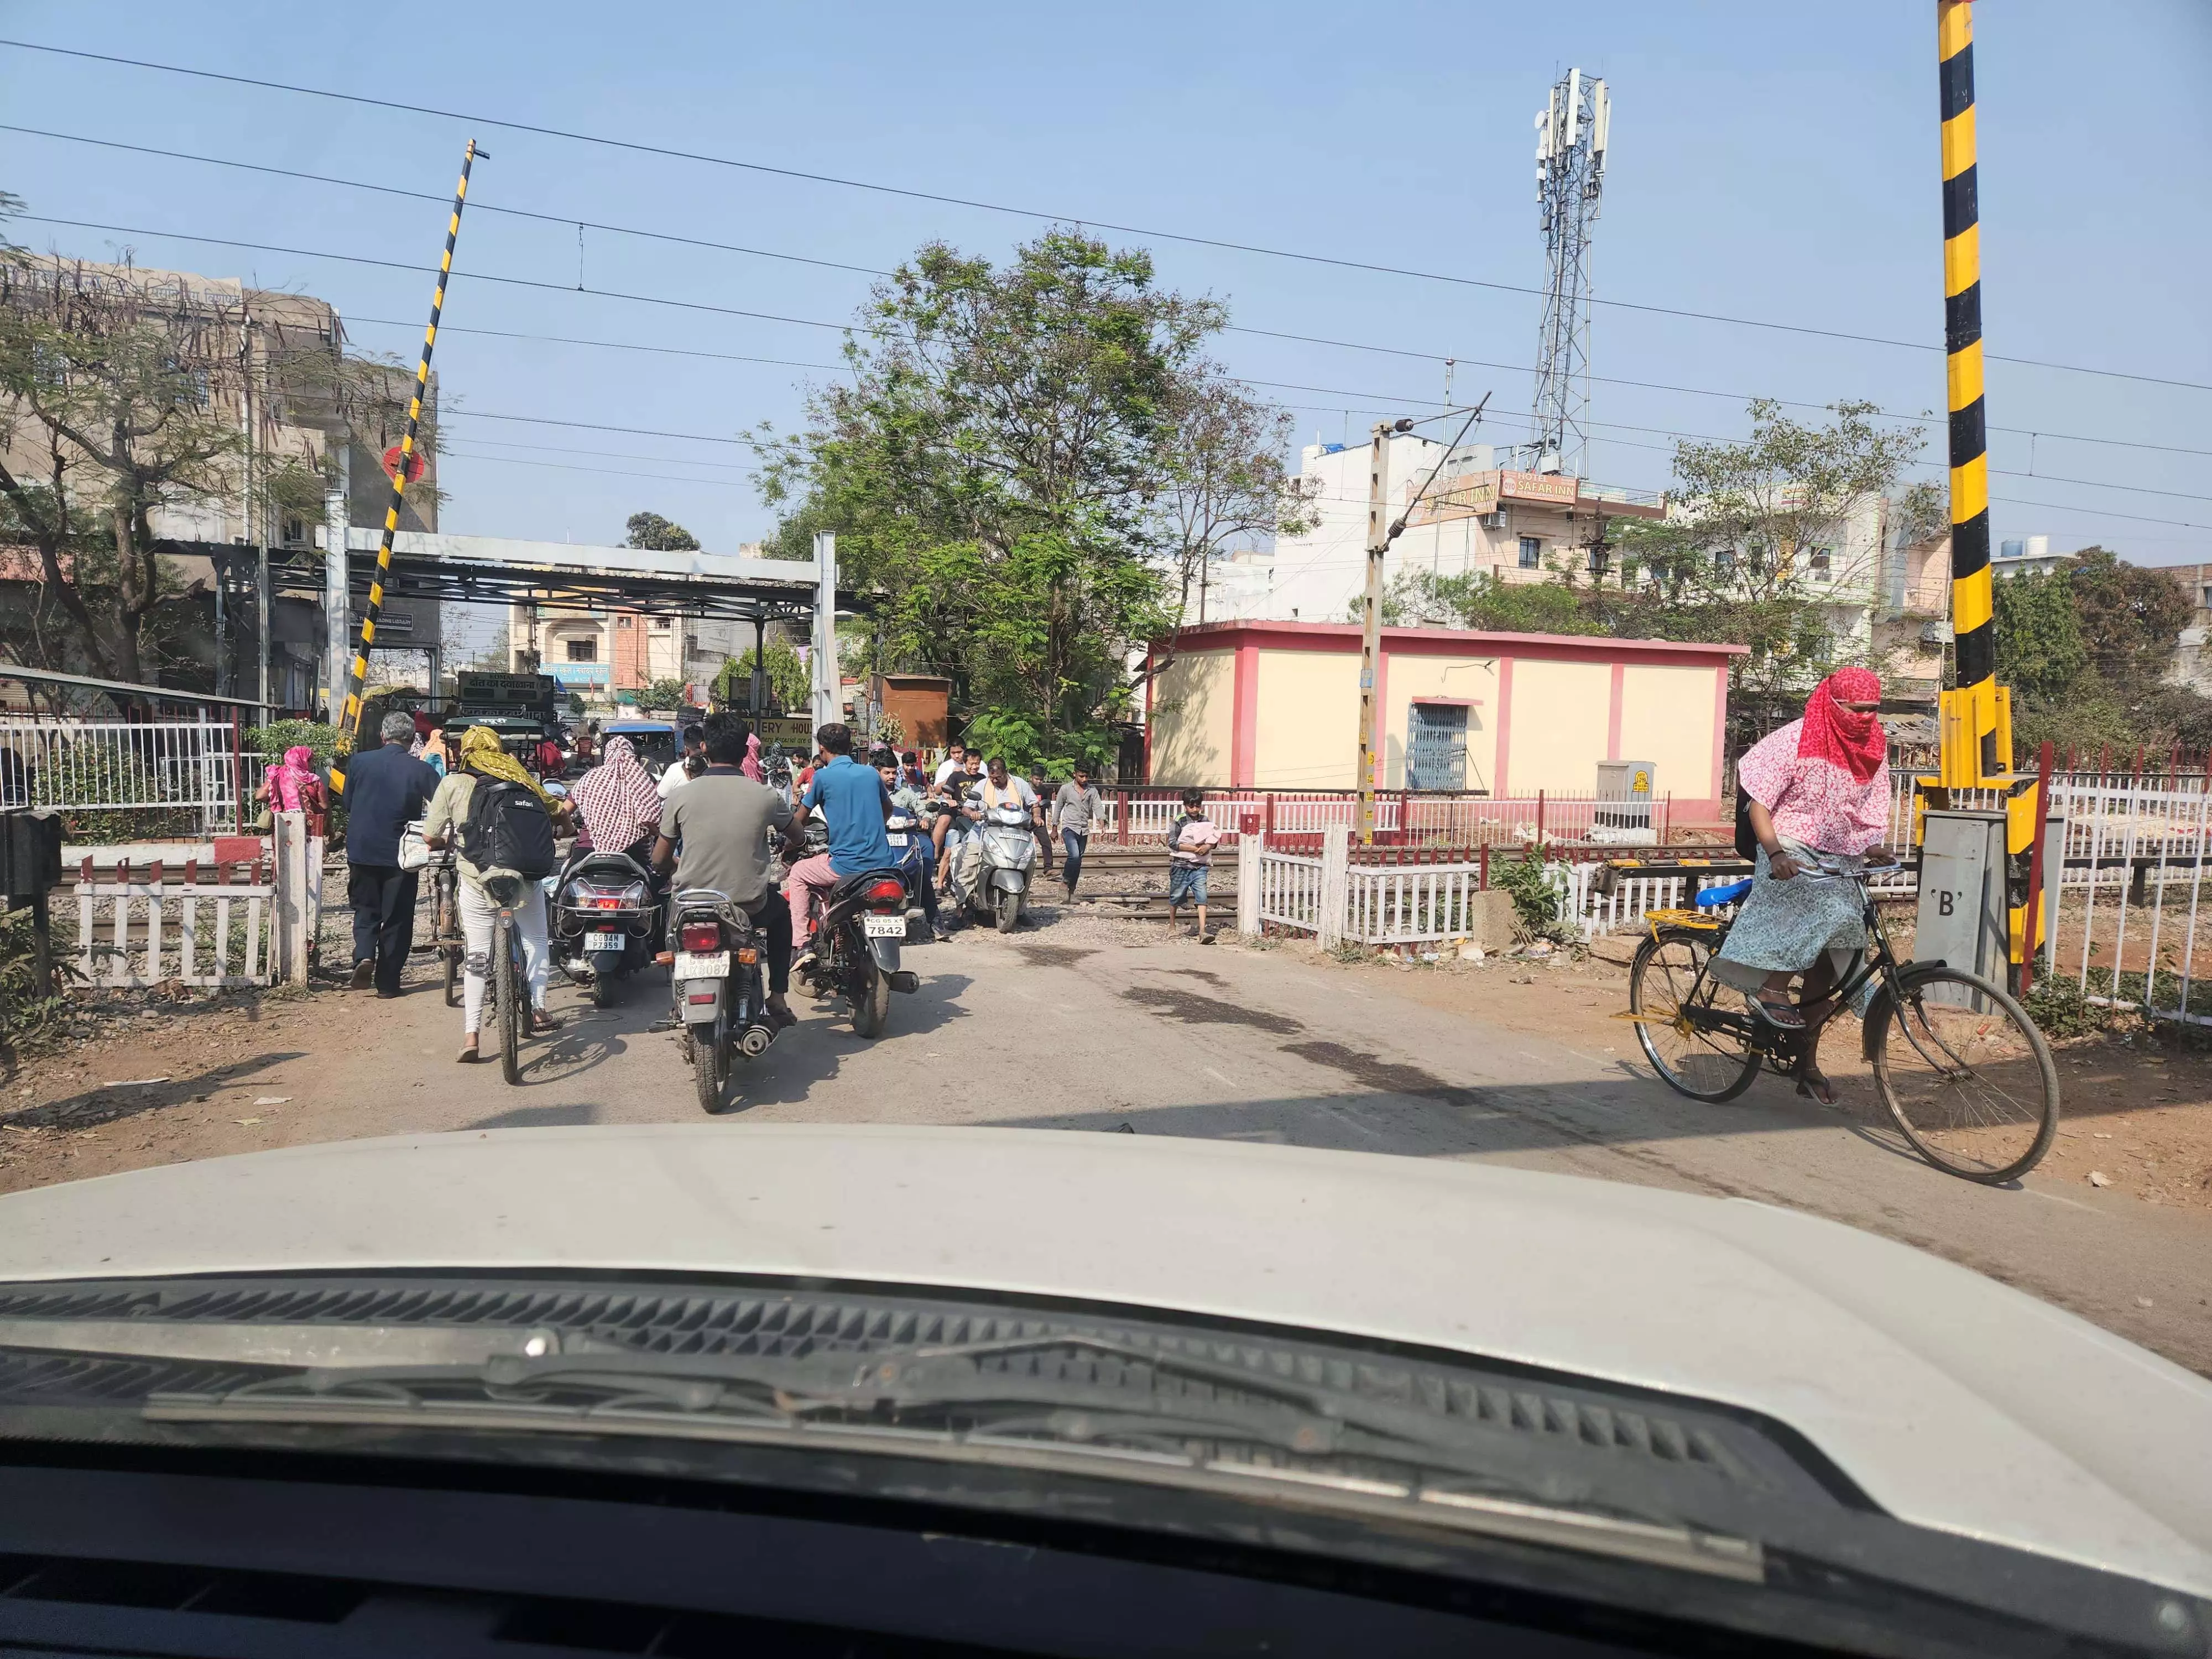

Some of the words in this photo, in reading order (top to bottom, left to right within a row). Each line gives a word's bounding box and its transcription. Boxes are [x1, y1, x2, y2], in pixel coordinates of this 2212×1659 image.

[1517, 472, 1547, 483] HOTEL
[1470, 484, 1496, 504] INN
[1517, 481, 1553, 494] SAFAR
[1555, 486, 1574, 496] INN
